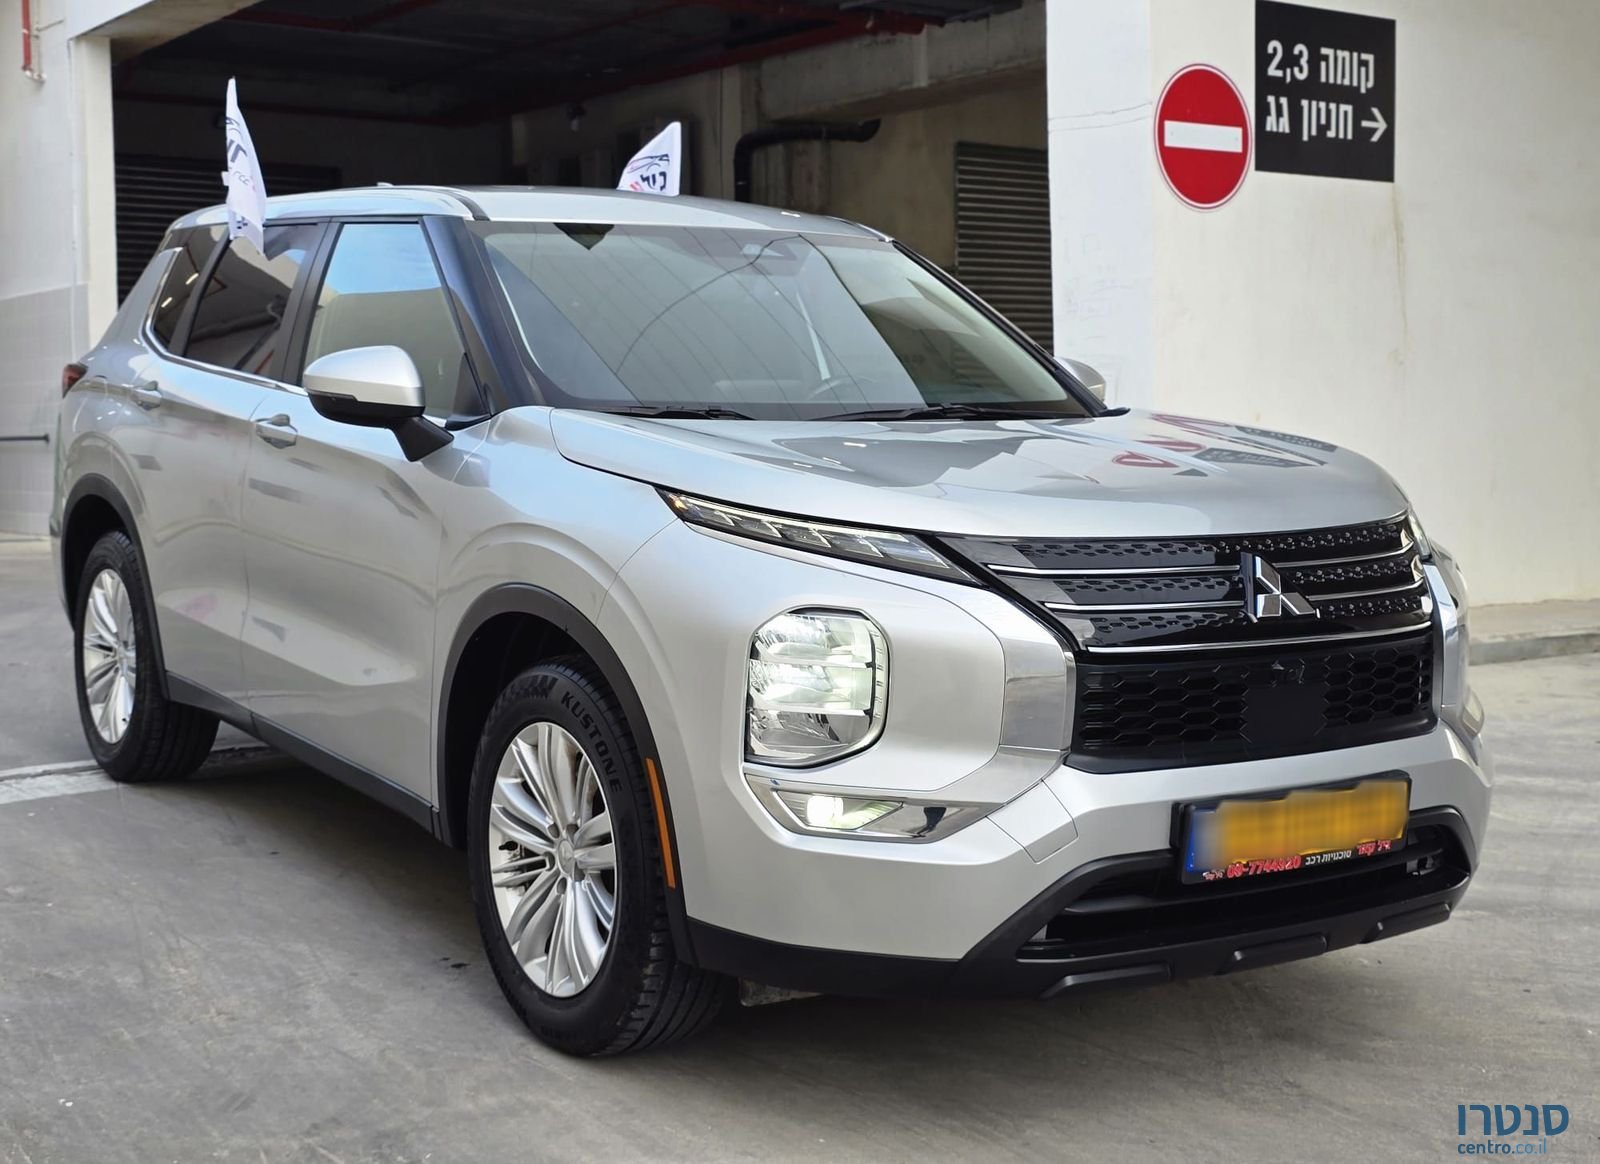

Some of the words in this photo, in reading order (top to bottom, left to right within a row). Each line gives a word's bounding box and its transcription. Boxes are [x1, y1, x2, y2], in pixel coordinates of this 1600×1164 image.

[1266, 39, 1309, 84] 2,3
[1320, 46, 1375, 94] קומה
[1265, 94, 1291, 134] גג
[1301, 98, 1353, 142] חניון
[561, 691, 622, 793] KUSTONE
[1305, 854, 1320, 866] רכב
